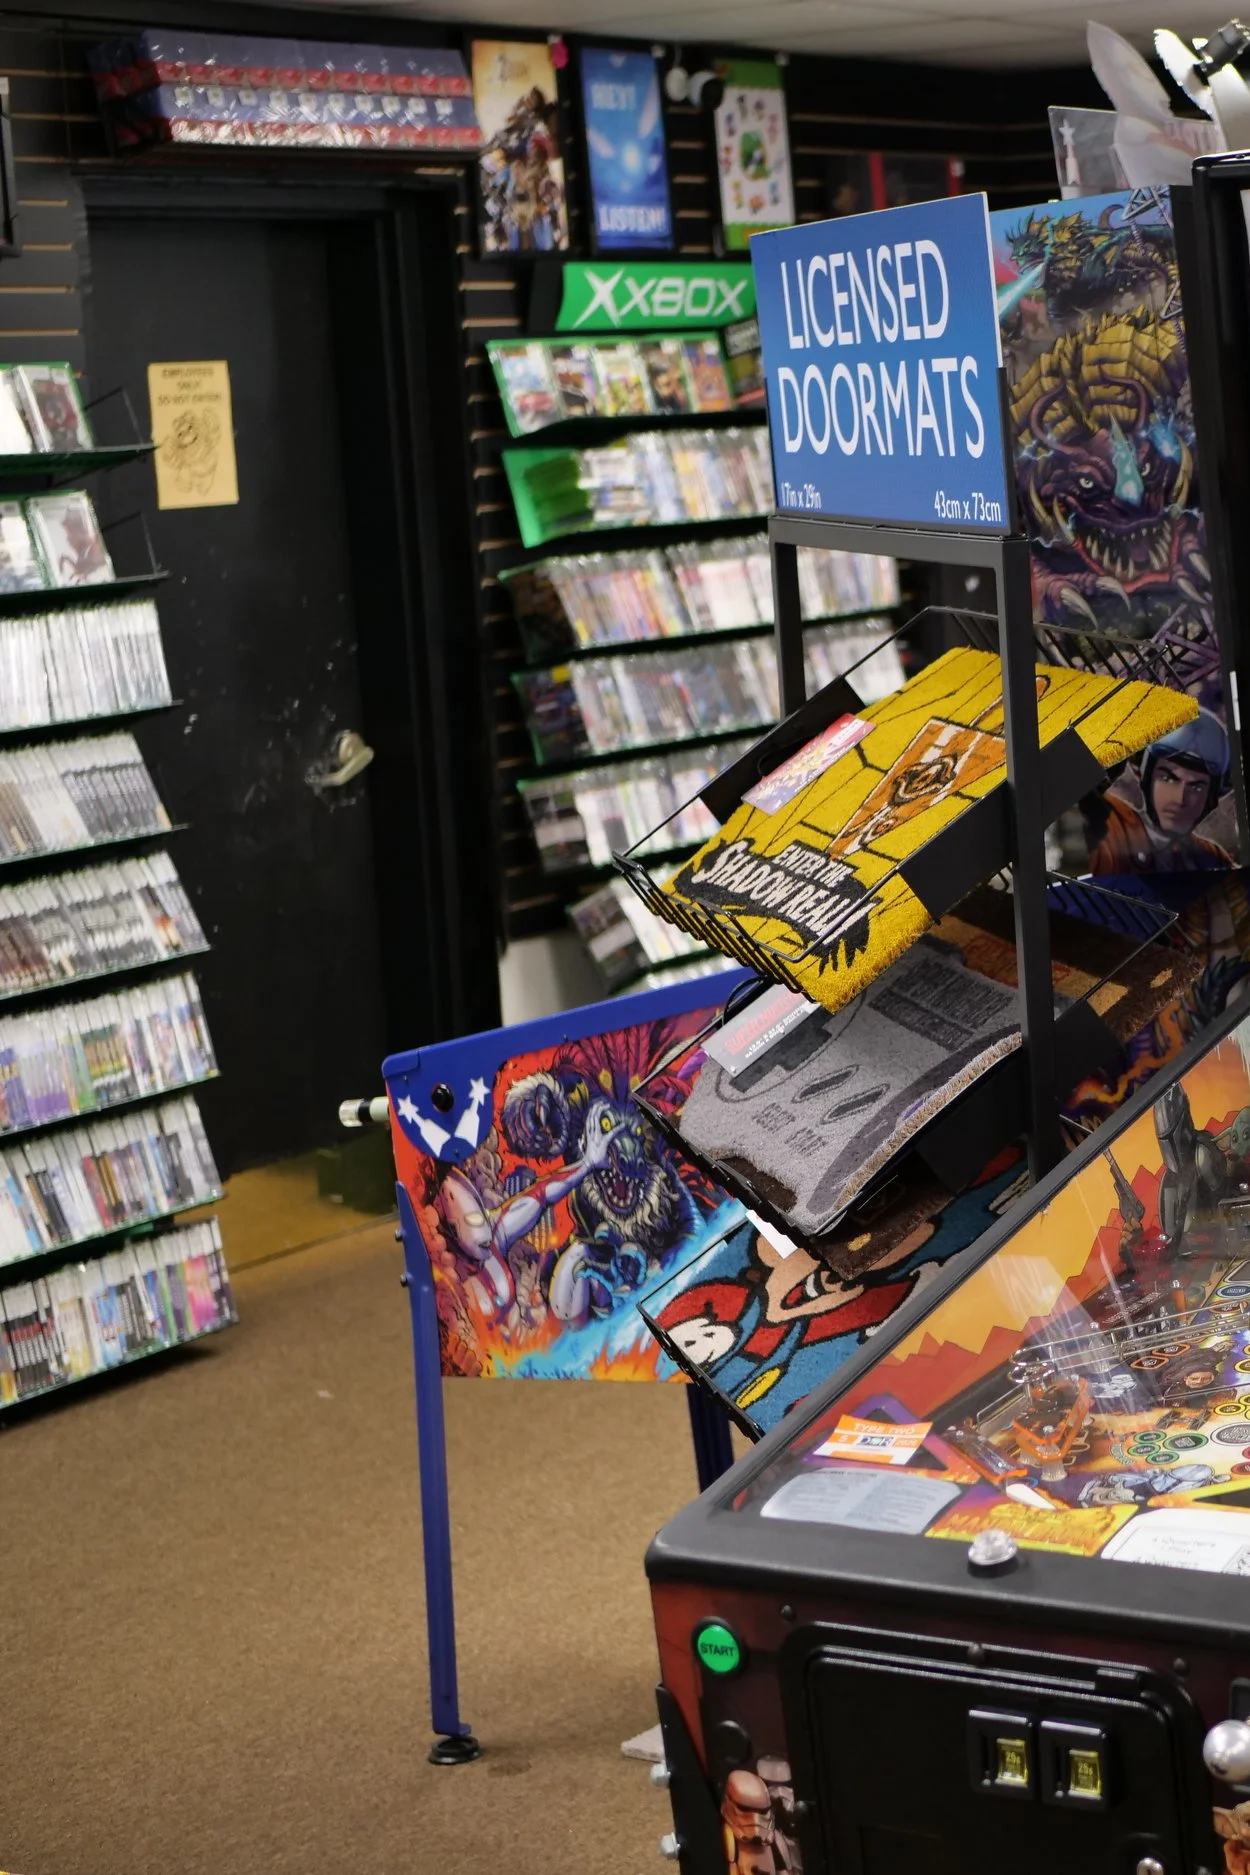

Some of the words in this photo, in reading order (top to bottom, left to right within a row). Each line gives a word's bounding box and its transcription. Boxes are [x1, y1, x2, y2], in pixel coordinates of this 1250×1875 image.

[591, 82, 637, 110] HEY!
[599, 204, 666, 233] LISTEN!
[781, 239, 949, 349] LICENSED
[778, 355, 985, 458] DOORMATS
[934, 490, 961, 519] 43cm
[971, 492, 1002, 522] 73cm
[772, 844, 832, 879] ENTER
[815, 861, 854, 889] THE
[854, 1423, 885, 1434] TYPE
[888, 1426, 915, 1435] TWO
[699, 1642, 735, 1657] START
